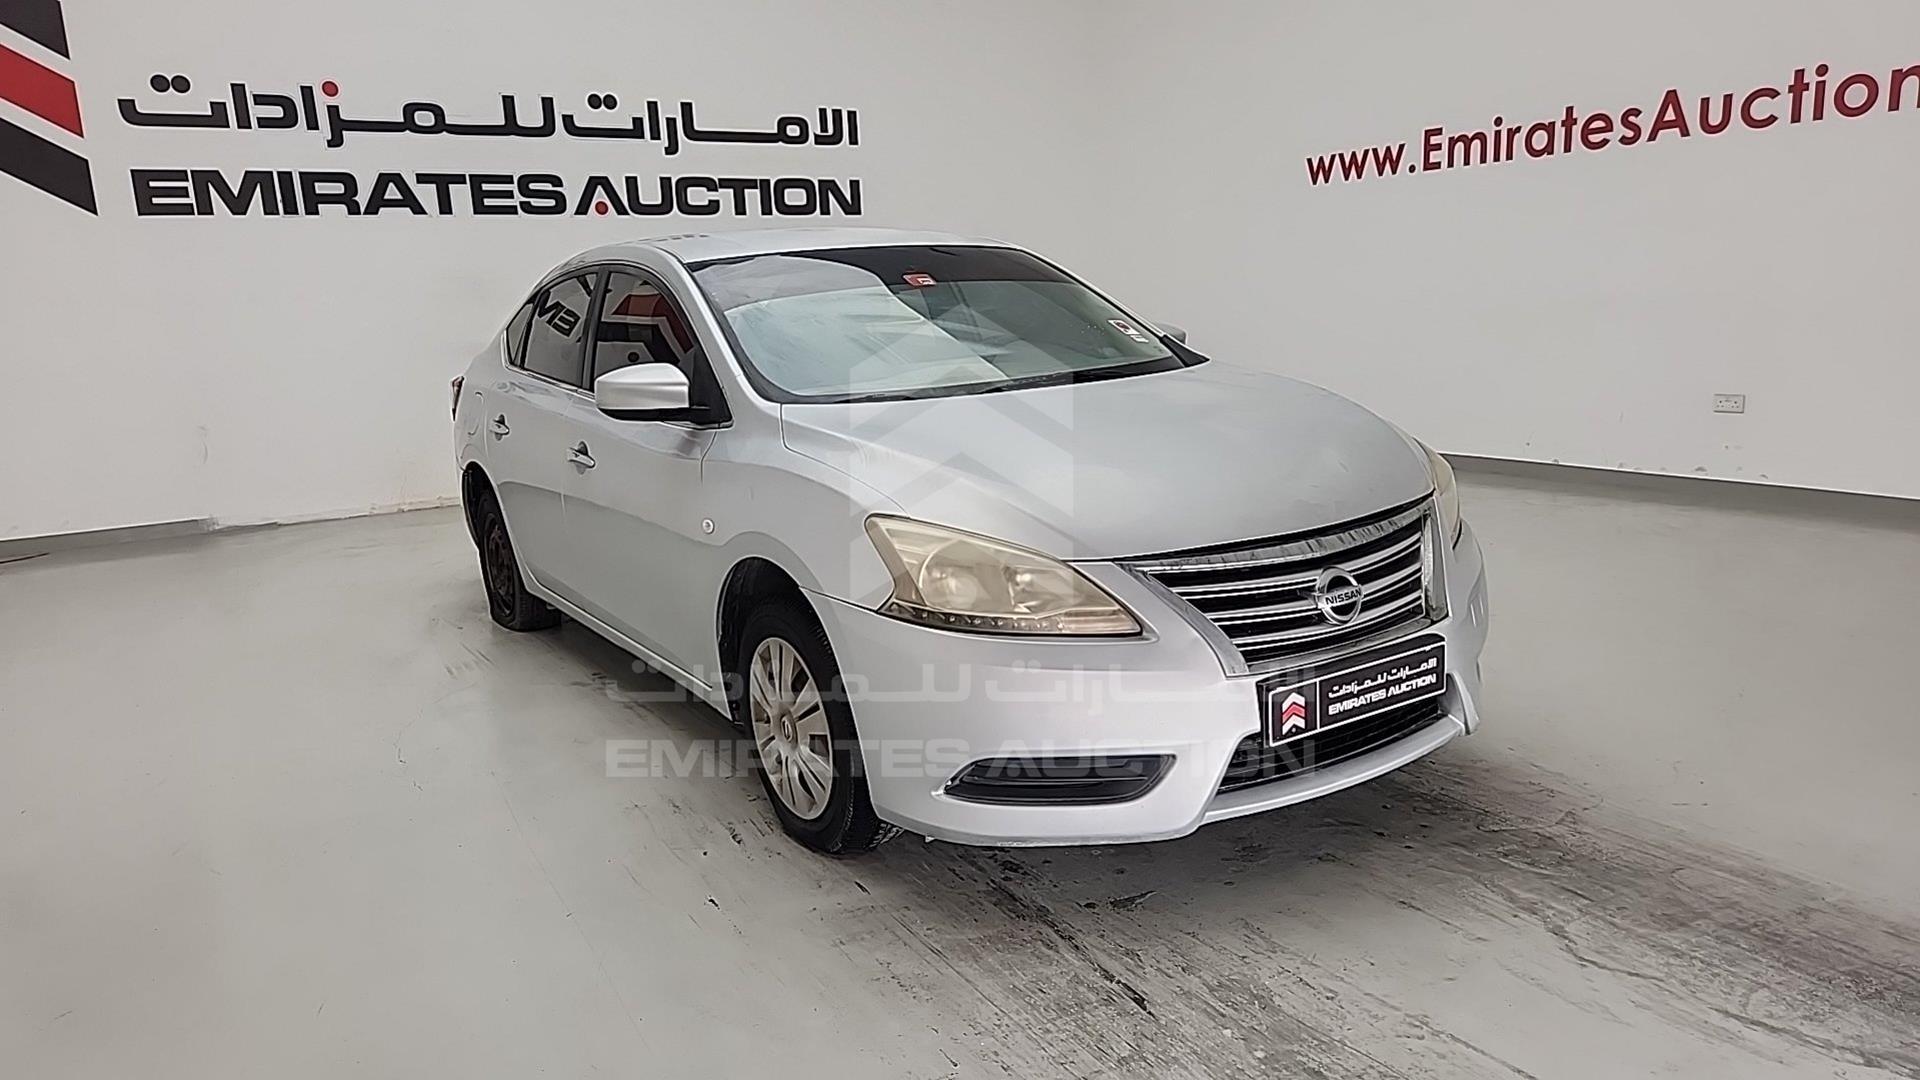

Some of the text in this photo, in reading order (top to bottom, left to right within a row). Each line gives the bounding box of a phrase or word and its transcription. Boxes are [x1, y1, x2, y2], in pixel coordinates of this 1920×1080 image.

[118, 74, 556, 148] للمزادات
[1306, 63, 1920, 186] www.EmiratesAuction
[130, 169, 862, 216] EMIRATES AUCTION
[1325, 588, 1362, 605] NISSAN
[1328, 674, 1437, 716] EMIRATES AUCTION
